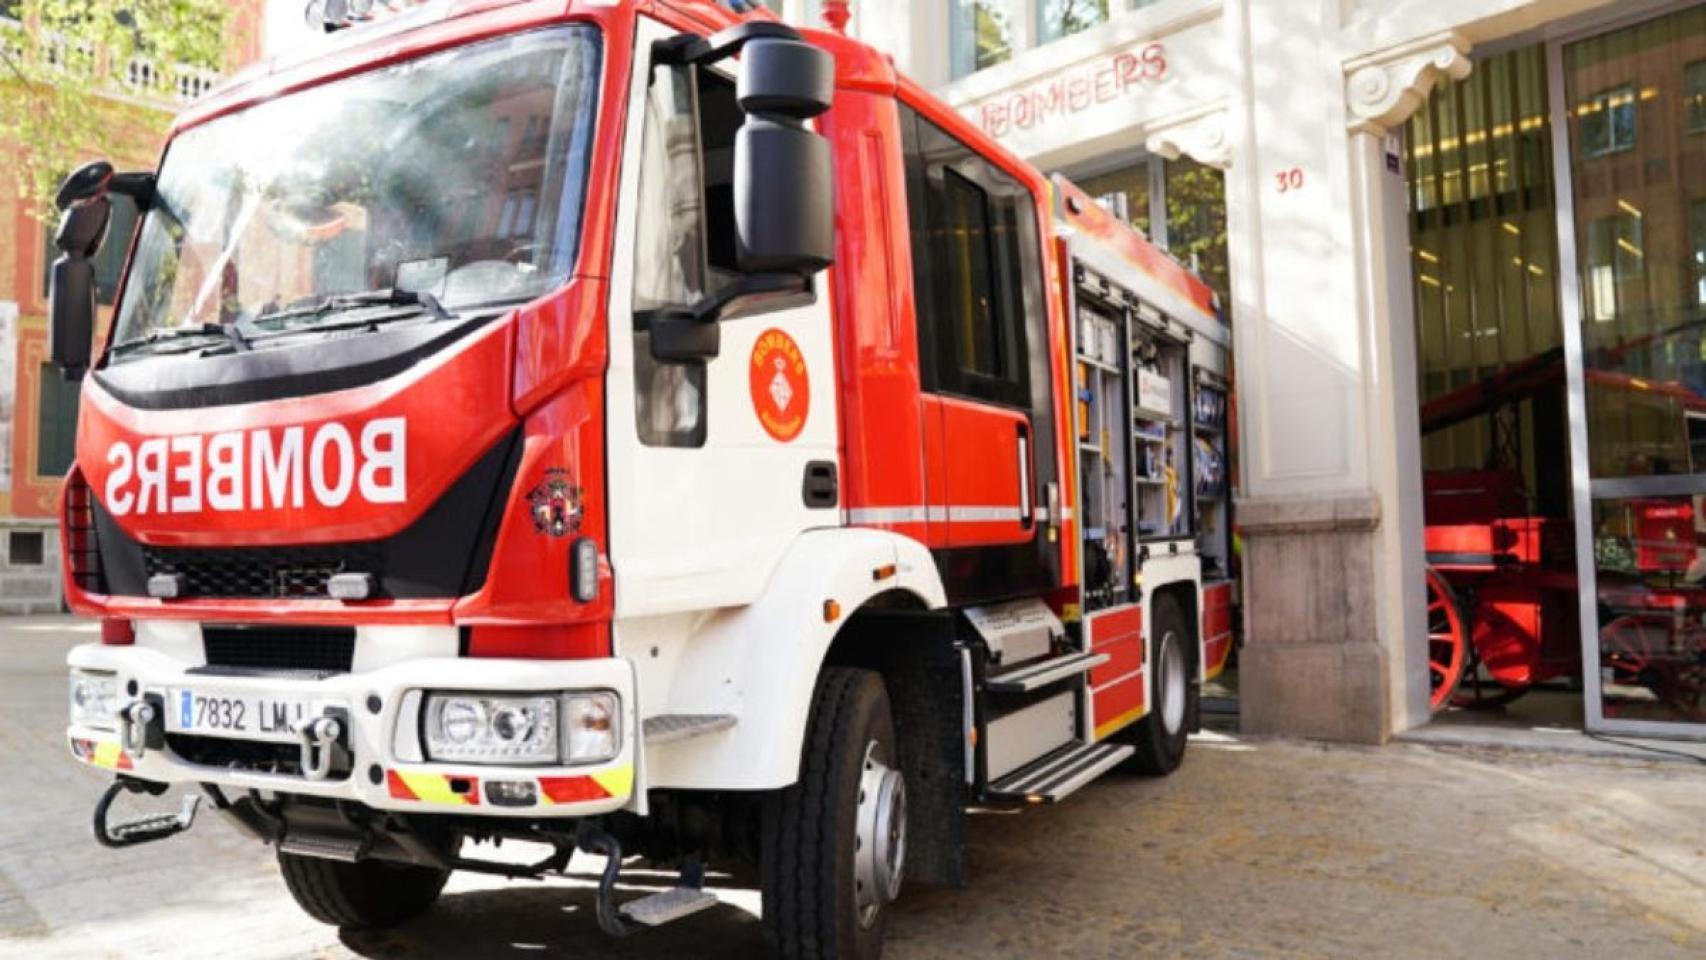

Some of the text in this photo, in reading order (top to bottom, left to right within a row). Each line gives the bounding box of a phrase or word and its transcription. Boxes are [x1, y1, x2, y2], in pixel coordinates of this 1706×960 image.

[982, 44, 1168, 137] BOMBERS
[1275, 168, 1304, 192] 30
[196, 696, 246, 731] 7832
